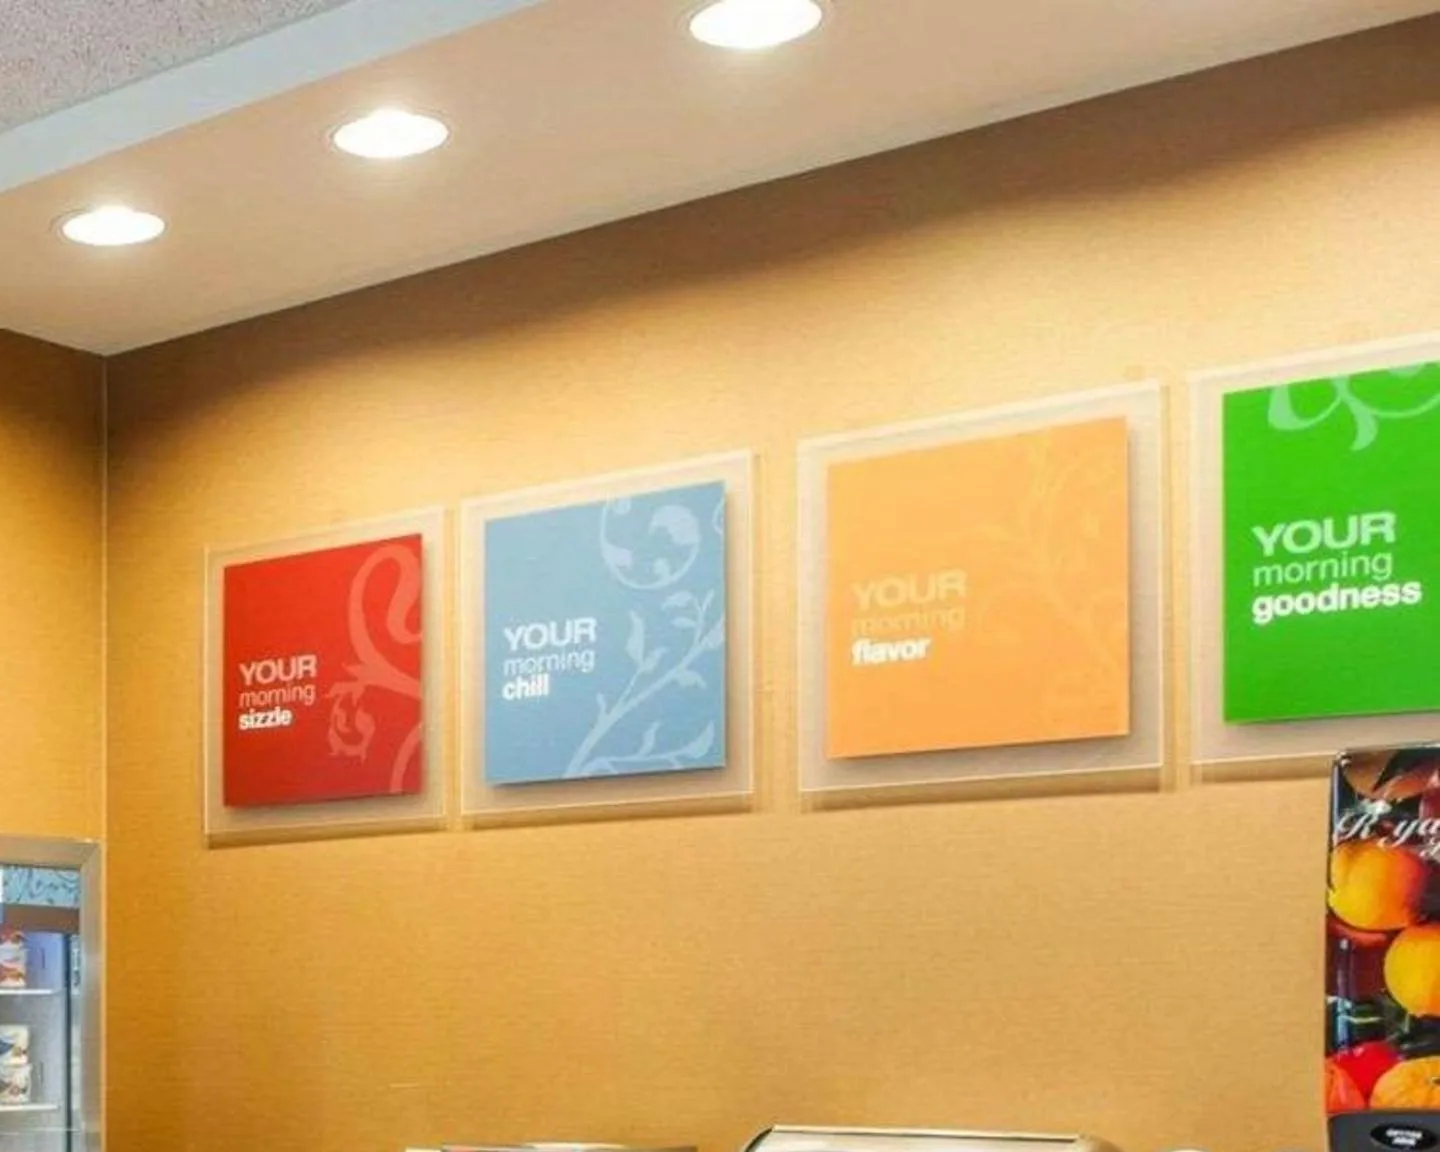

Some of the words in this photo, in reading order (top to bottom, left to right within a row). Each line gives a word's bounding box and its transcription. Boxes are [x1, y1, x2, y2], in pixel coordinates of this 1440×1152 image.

[1251, 511, 1396, 557] YOUR
[1252, 551, 1394, 587] morning
[849, 568, 967, 612] YOUR
[1252, 581, 1423, 625] goodness
[503, 617, 598, 651] YOUR
[503, 648, 597, 676] morning
[851, 637, 931, 667] flavor
[239, 654, 318, 686] YOUR
[239, 684, 316, 709] morning
[502, 673, 550, 701] chill
[238, 706, 294, 731] sizzle
